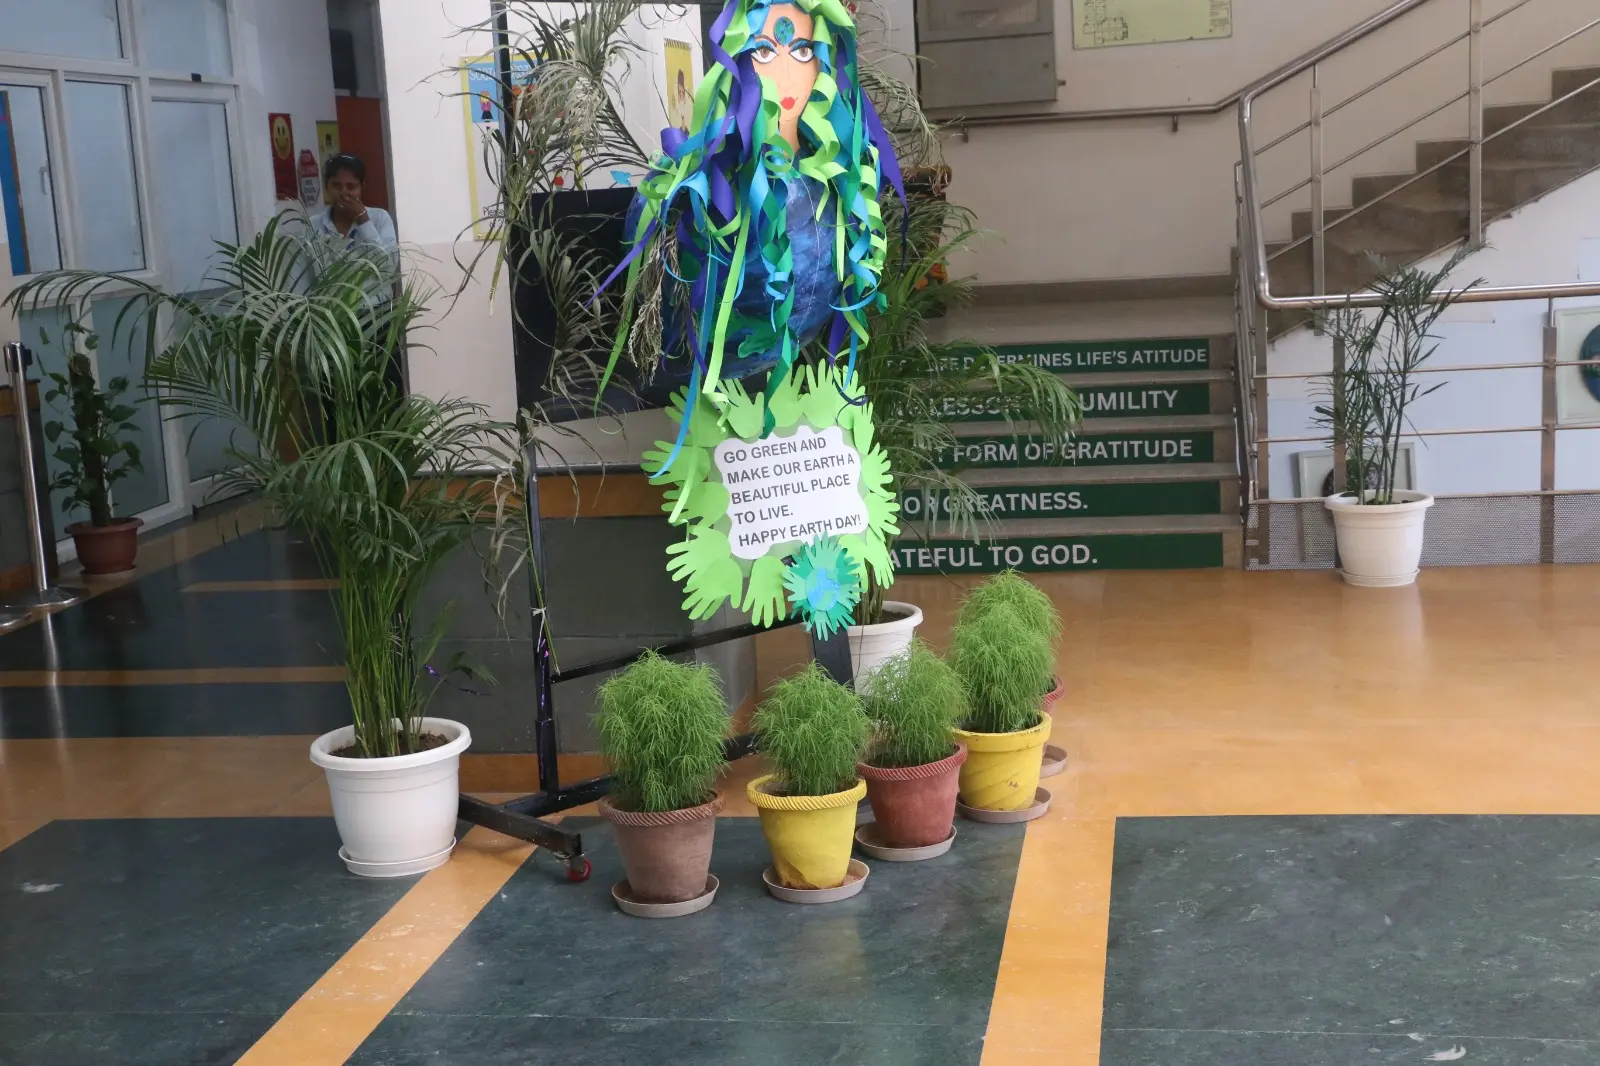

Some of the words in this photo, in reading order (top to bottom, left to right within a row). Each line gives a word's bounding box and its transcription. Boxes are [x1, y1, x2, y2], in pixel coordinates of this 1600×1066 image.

[1131, 348, 1207, 363] ATITUDE
[1081, 390, 1179, 411] UMILITY
[723, 449, 747, 464] GO
[750, 442, 798, 459] GREEN
[800, 437, 827, 452] AND
[953, 443, 1018, 463] FORM
[1061, 439, 1194, 460] GRATITUDE
[727, 466, 771, 484] MAKE
[773, 461, 802, 477] OUR
[803, 454, 846, 472] EARTH
[847, 452, 855, 465] A
[731, 481, 809, 505] BEAUTIFUL
[811, 473, 851, 491] PLACE
[942, 491, 1089, 513] GREATNESS.
[734, 511, 756, 525] TO
[759, 504, 794, 521] LIVE.
[738, 527, 787, 548] HAPPY
[790, 519, 833, 538] EARTH
[835, 513, 862, 529] DAY!
[890, 547, 983, 568] ATEFUL
[988, 545, 1024, 566] TO
[1031, 544, 1099, 565] GOD.
